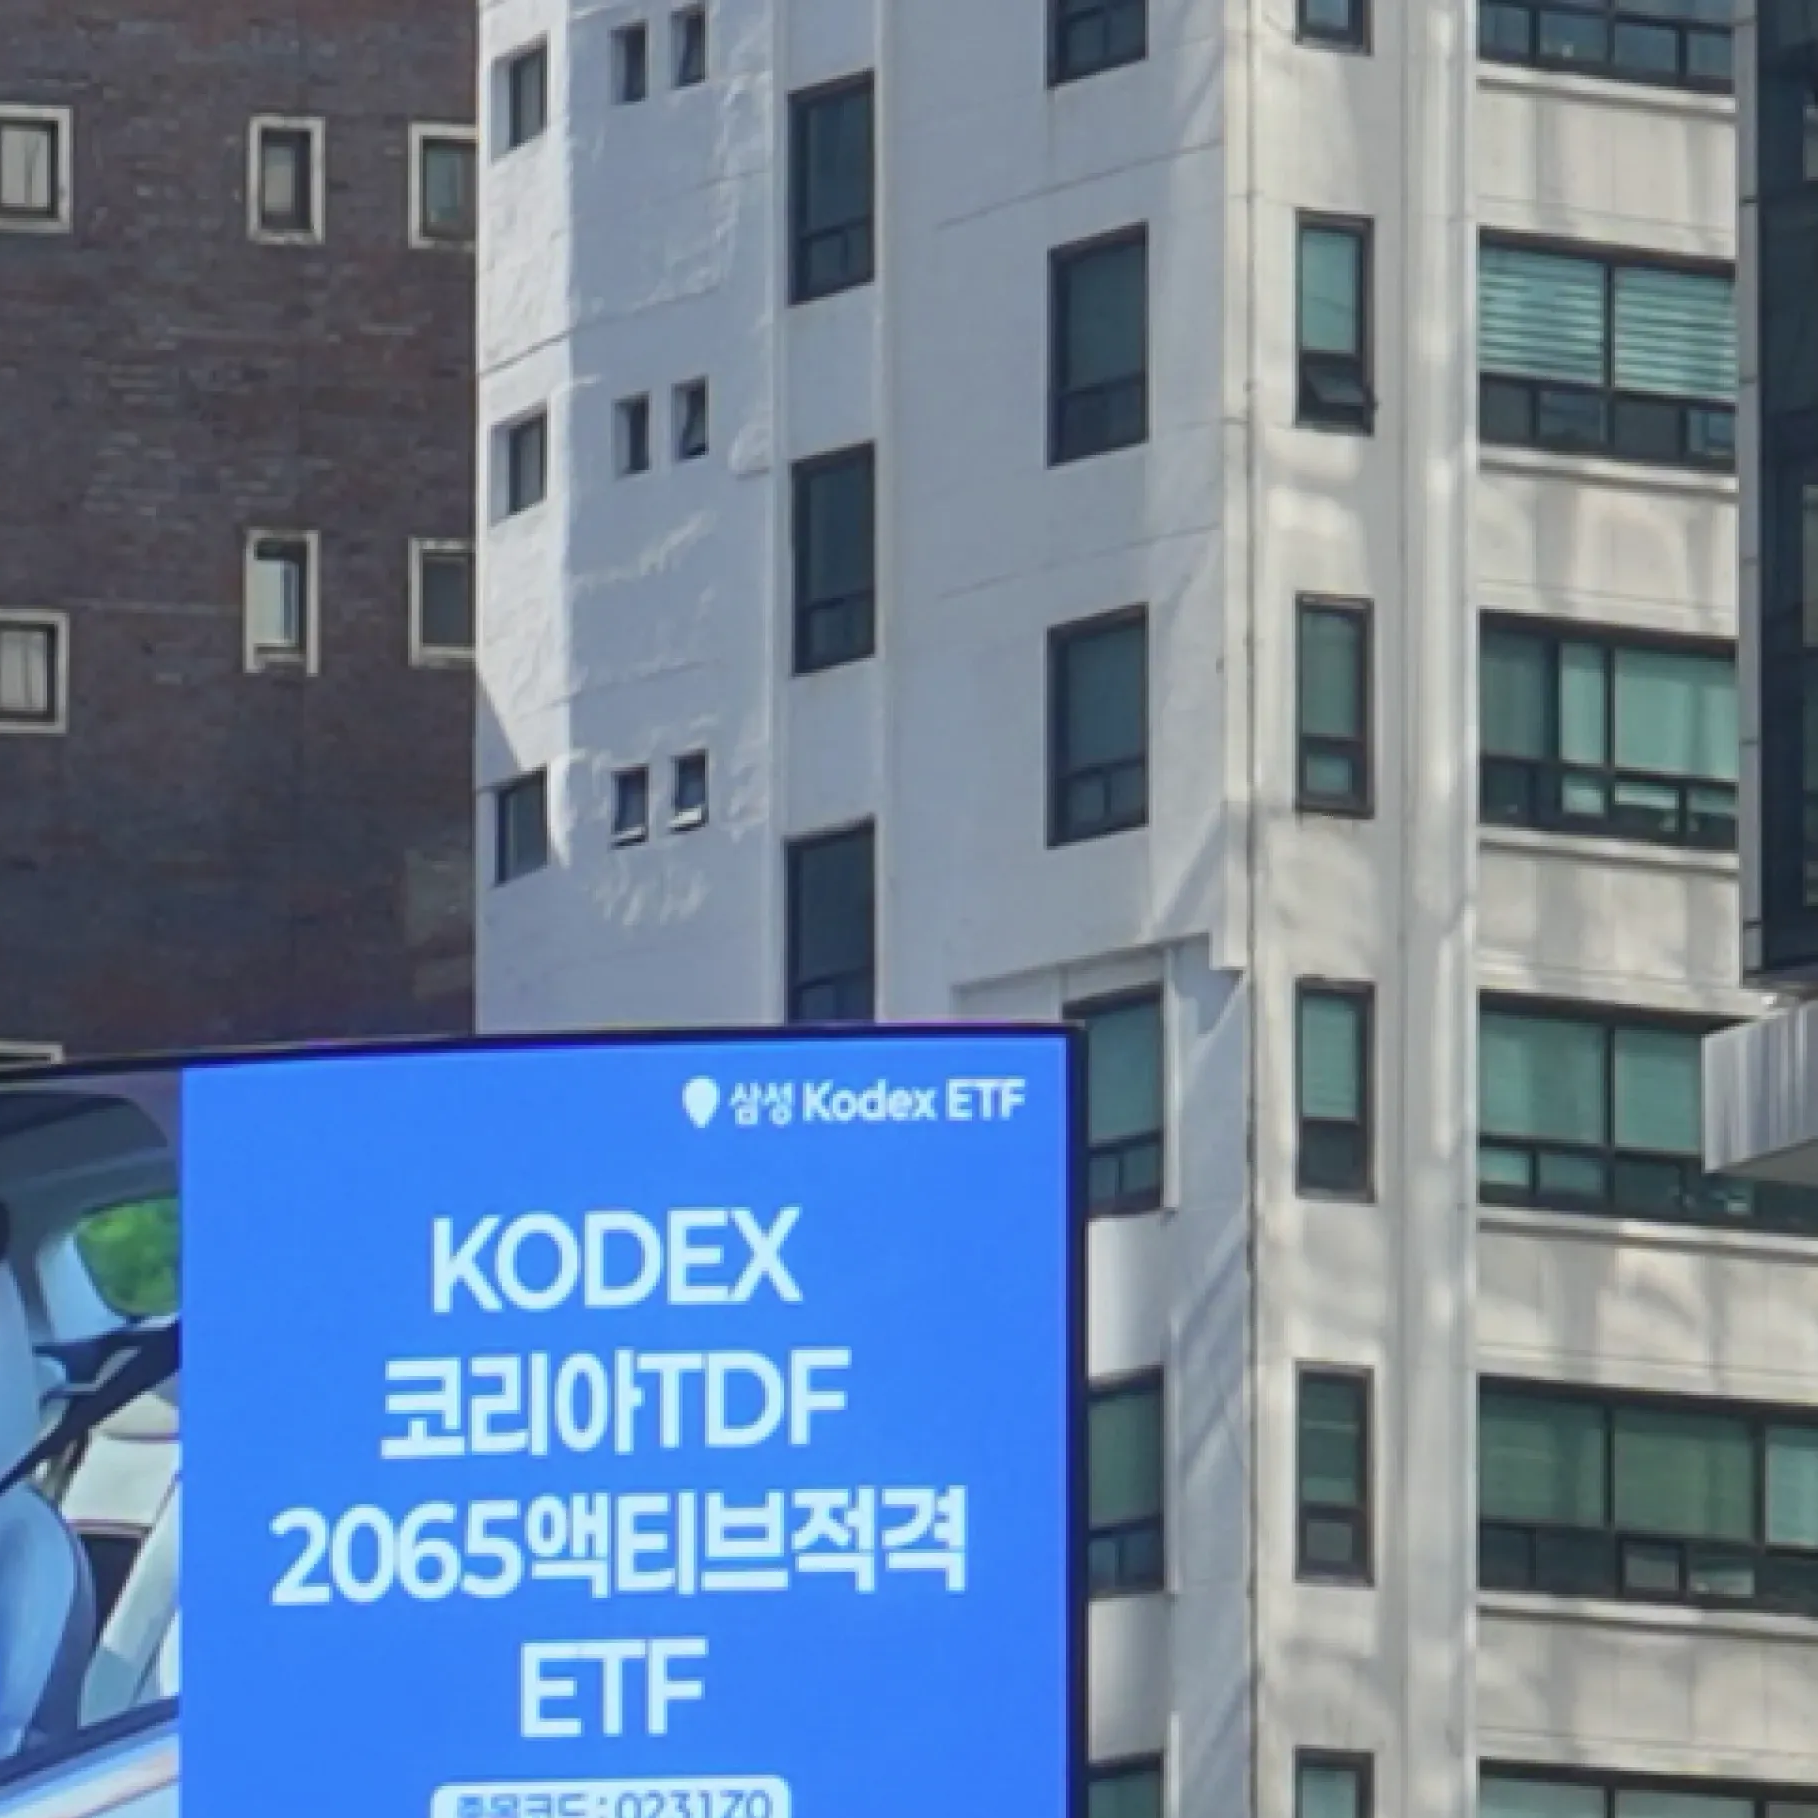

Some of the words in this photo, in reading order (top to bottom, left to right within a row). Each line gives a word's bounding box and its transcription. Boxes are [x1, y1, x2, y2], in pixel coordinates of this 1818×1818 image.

[730, 1079, 796, 1128] 삼성
[802, 1078, 939, 1122] Kodex
[945, 1078, 1026, 1121] ETF
[432, 1206, 804, 1313] KODEX
[381, 1347, 852, 1460] 코리아TDF
[270, 1485, 967, 1606] 2065액티브적격
[520, 1636, 709, 1739] ETF
